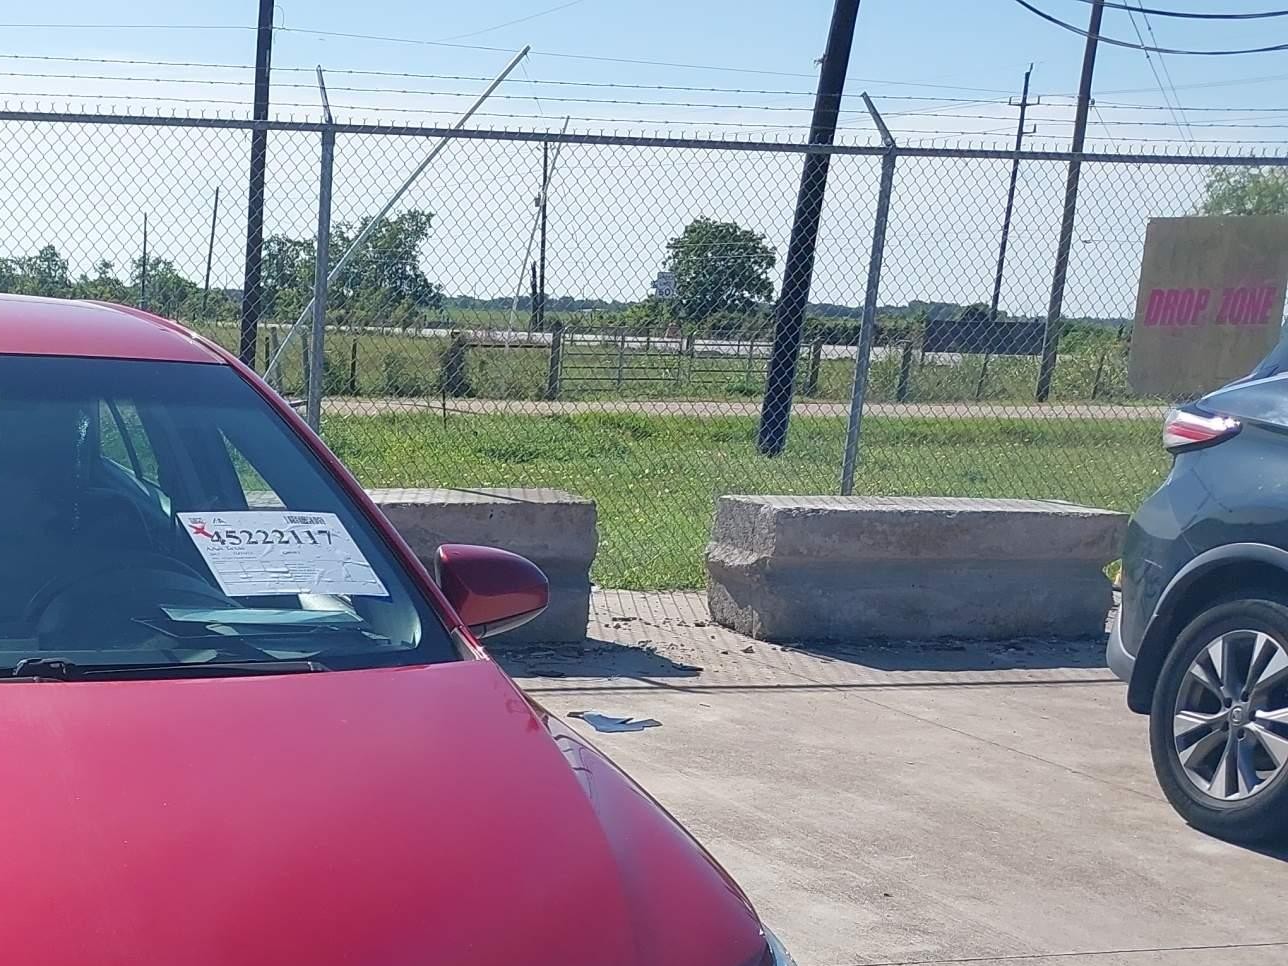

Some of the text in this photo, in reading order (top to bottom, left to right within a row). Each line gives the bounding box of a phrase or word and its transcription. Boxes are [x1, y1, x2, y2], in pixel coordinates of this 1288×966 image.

[1143, 287, 1278, 327] DROP ZONE
[210, 529, 334, 546] 45222117
